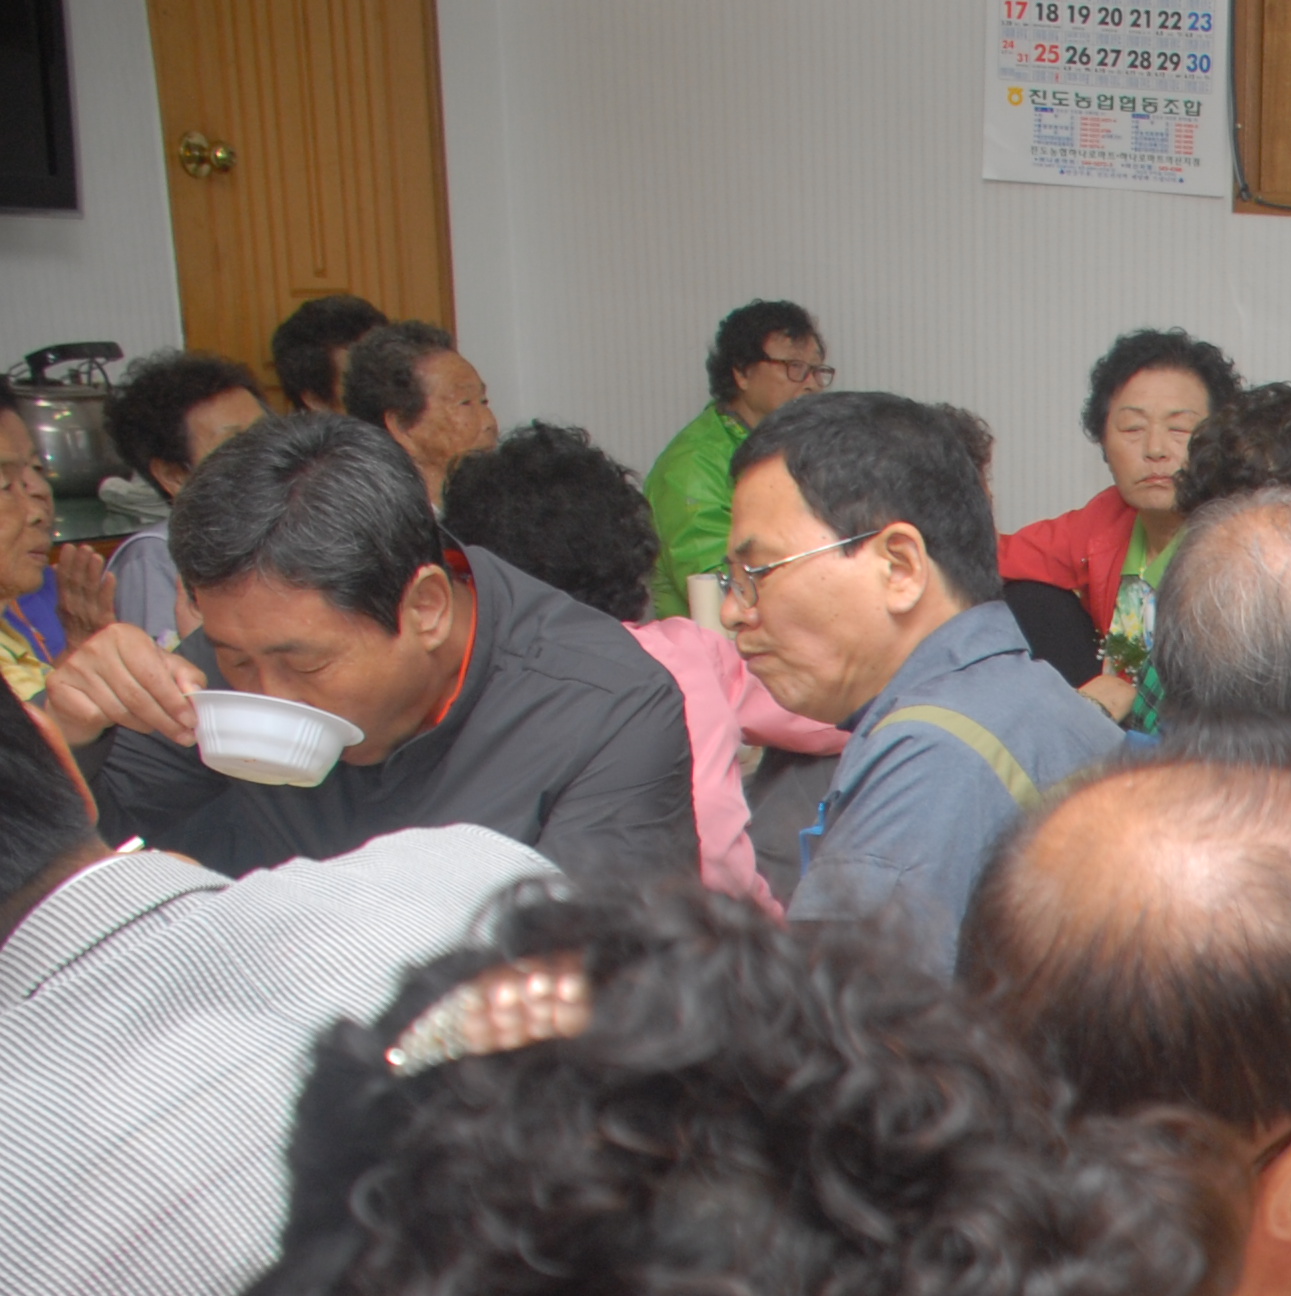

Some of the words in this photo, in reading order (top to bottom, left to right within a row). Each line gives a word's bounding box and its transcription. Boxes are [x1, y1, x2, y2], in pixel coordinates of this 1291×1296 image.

[1004, 1, 1028, 20] 17
[1036, 3, 1059, 22] 18
[1067, 5, 1091, 24] 19
[1097, 7, 1122, 27] 20
[1130, 9, 1152, 28] 21
[1158, 11, 1182, 30] 22
[1188, 12, 1212, 31] 23
[1002, 40, 1014, 49] 24
[1017, 53, 1029, 63] 31
[1034, 44, 1060, 64] 25
[1065, 46, 1091, 65] 26
[1097, 48, 1122, 67] 27
[1127, 50, 1152, 70] 28
[1157, 52, 1181, 71] 29
[1186, 54, 1211, 73] 30
[1028, 89, 1202, 116] 진도농업협동조합
